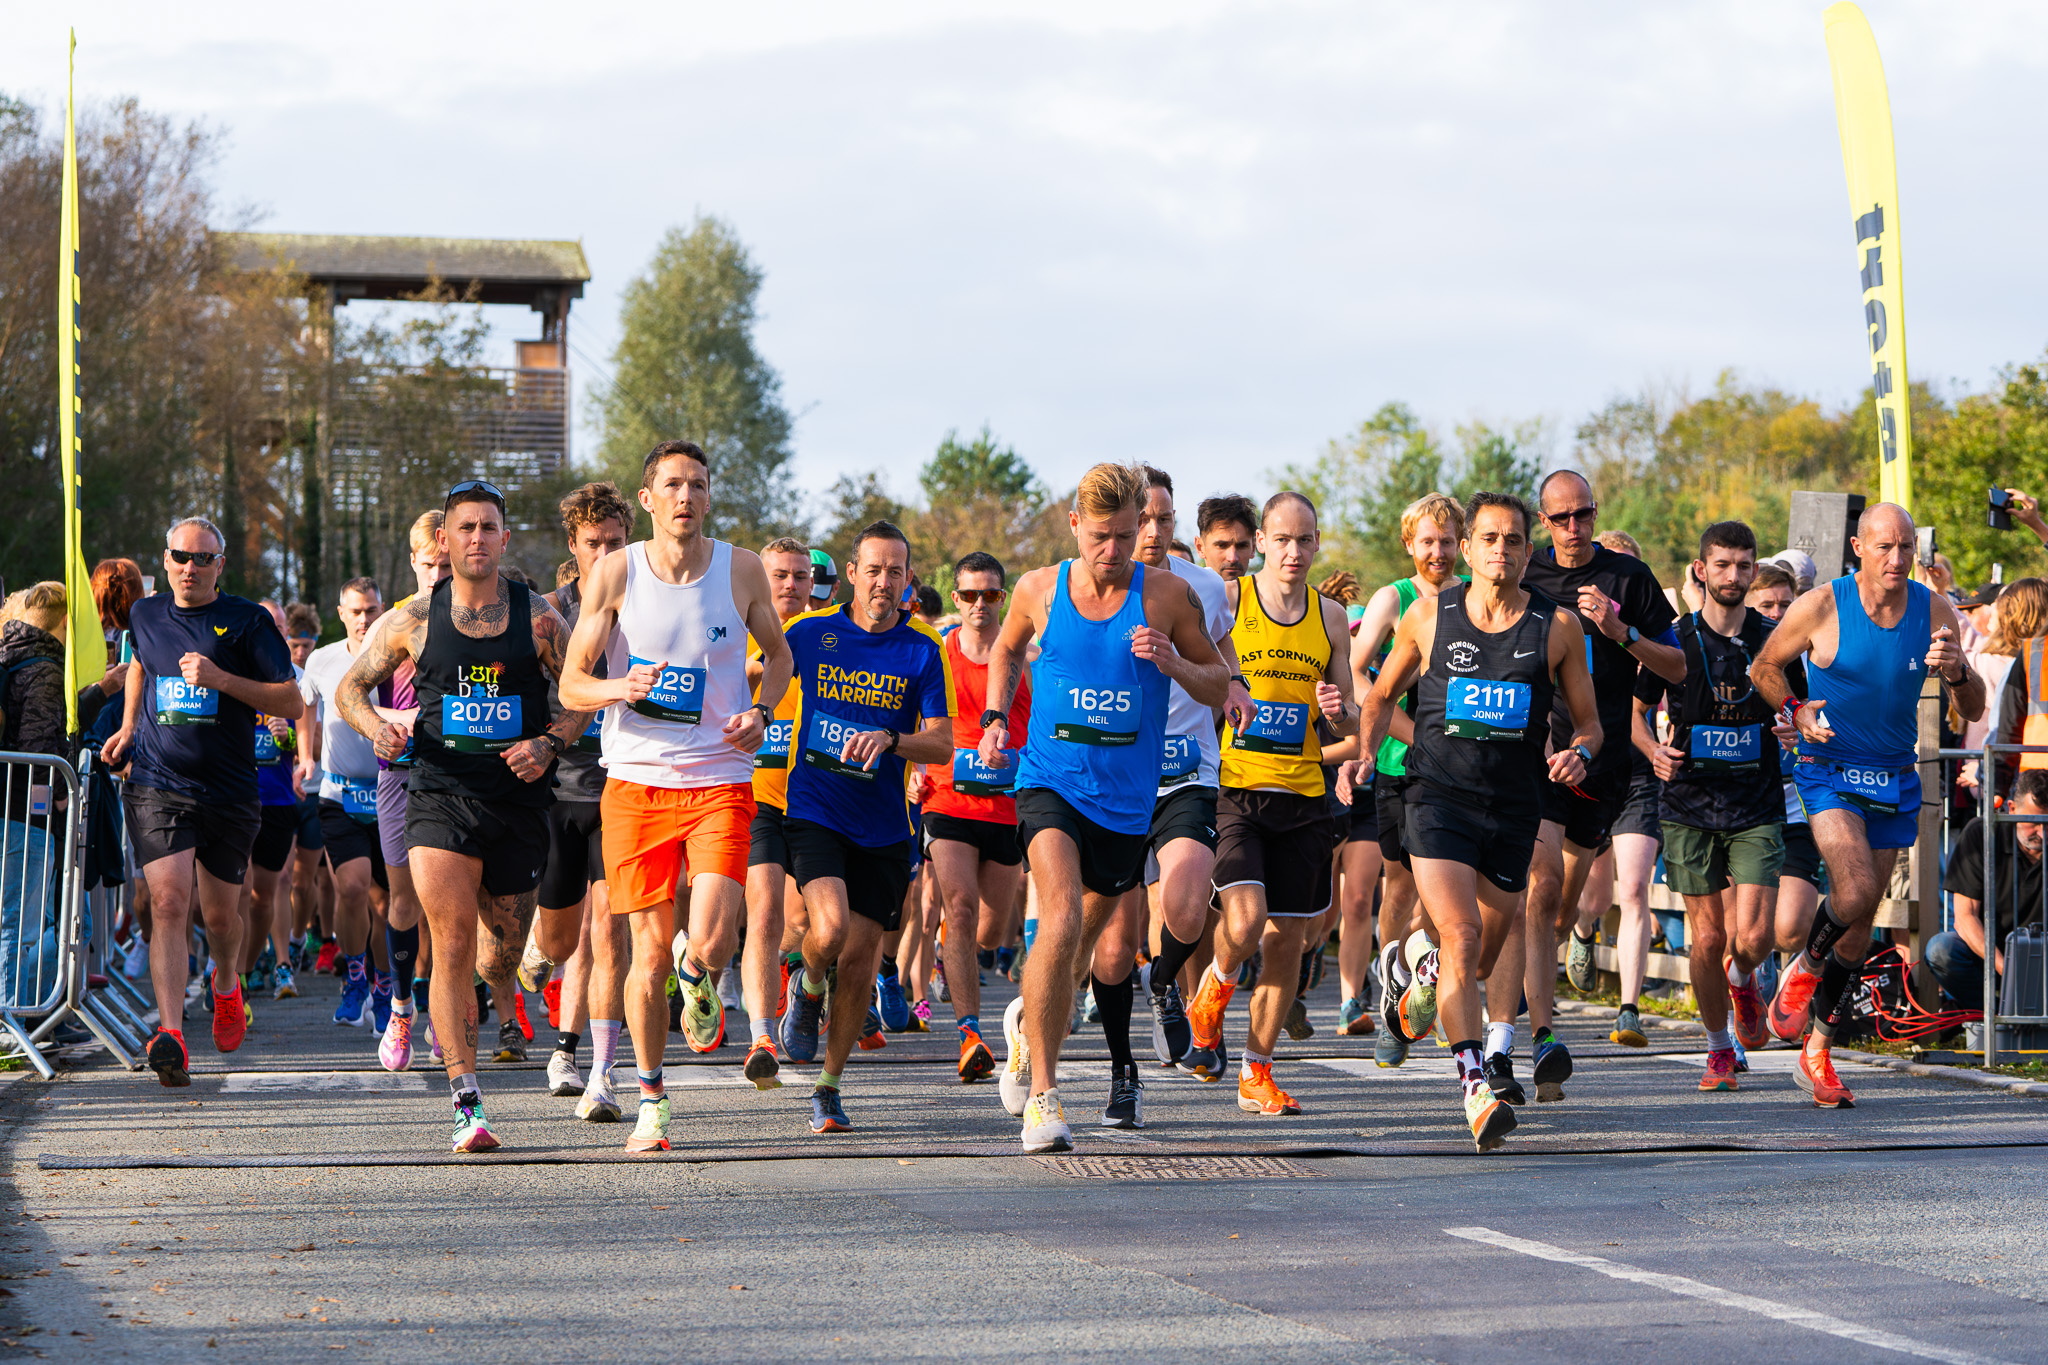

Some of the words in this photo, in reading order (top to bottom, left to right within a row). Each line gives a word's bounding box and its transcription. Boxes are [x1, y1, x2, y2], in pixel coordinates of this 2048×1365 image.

[1446, 641, 1480, 654] NEWQUAY
[1238, 650, 1262, 665] AST
[818, 664, 908, 693] EXMOUTH
[1253, 669, 1312, 682] HARRIERS
[165, 681, 208, 699] 1614
[817, 680, 904, 710] HARRIERS
[1464, 684, 1515, 708] 2111
[1069, 688, 1131, 712] 1625
[451, 702, 511, 721] 2076
[1088, 715, 1109, 724] NEIL
[1472, 710, 1505, 720] JONNY
[820, 720, 870, 744] 186
[1702, 730, 1752, 747] 1704
[965, 753, 1008, 770] 14
[1842, 768, 1888, 786] 1980
